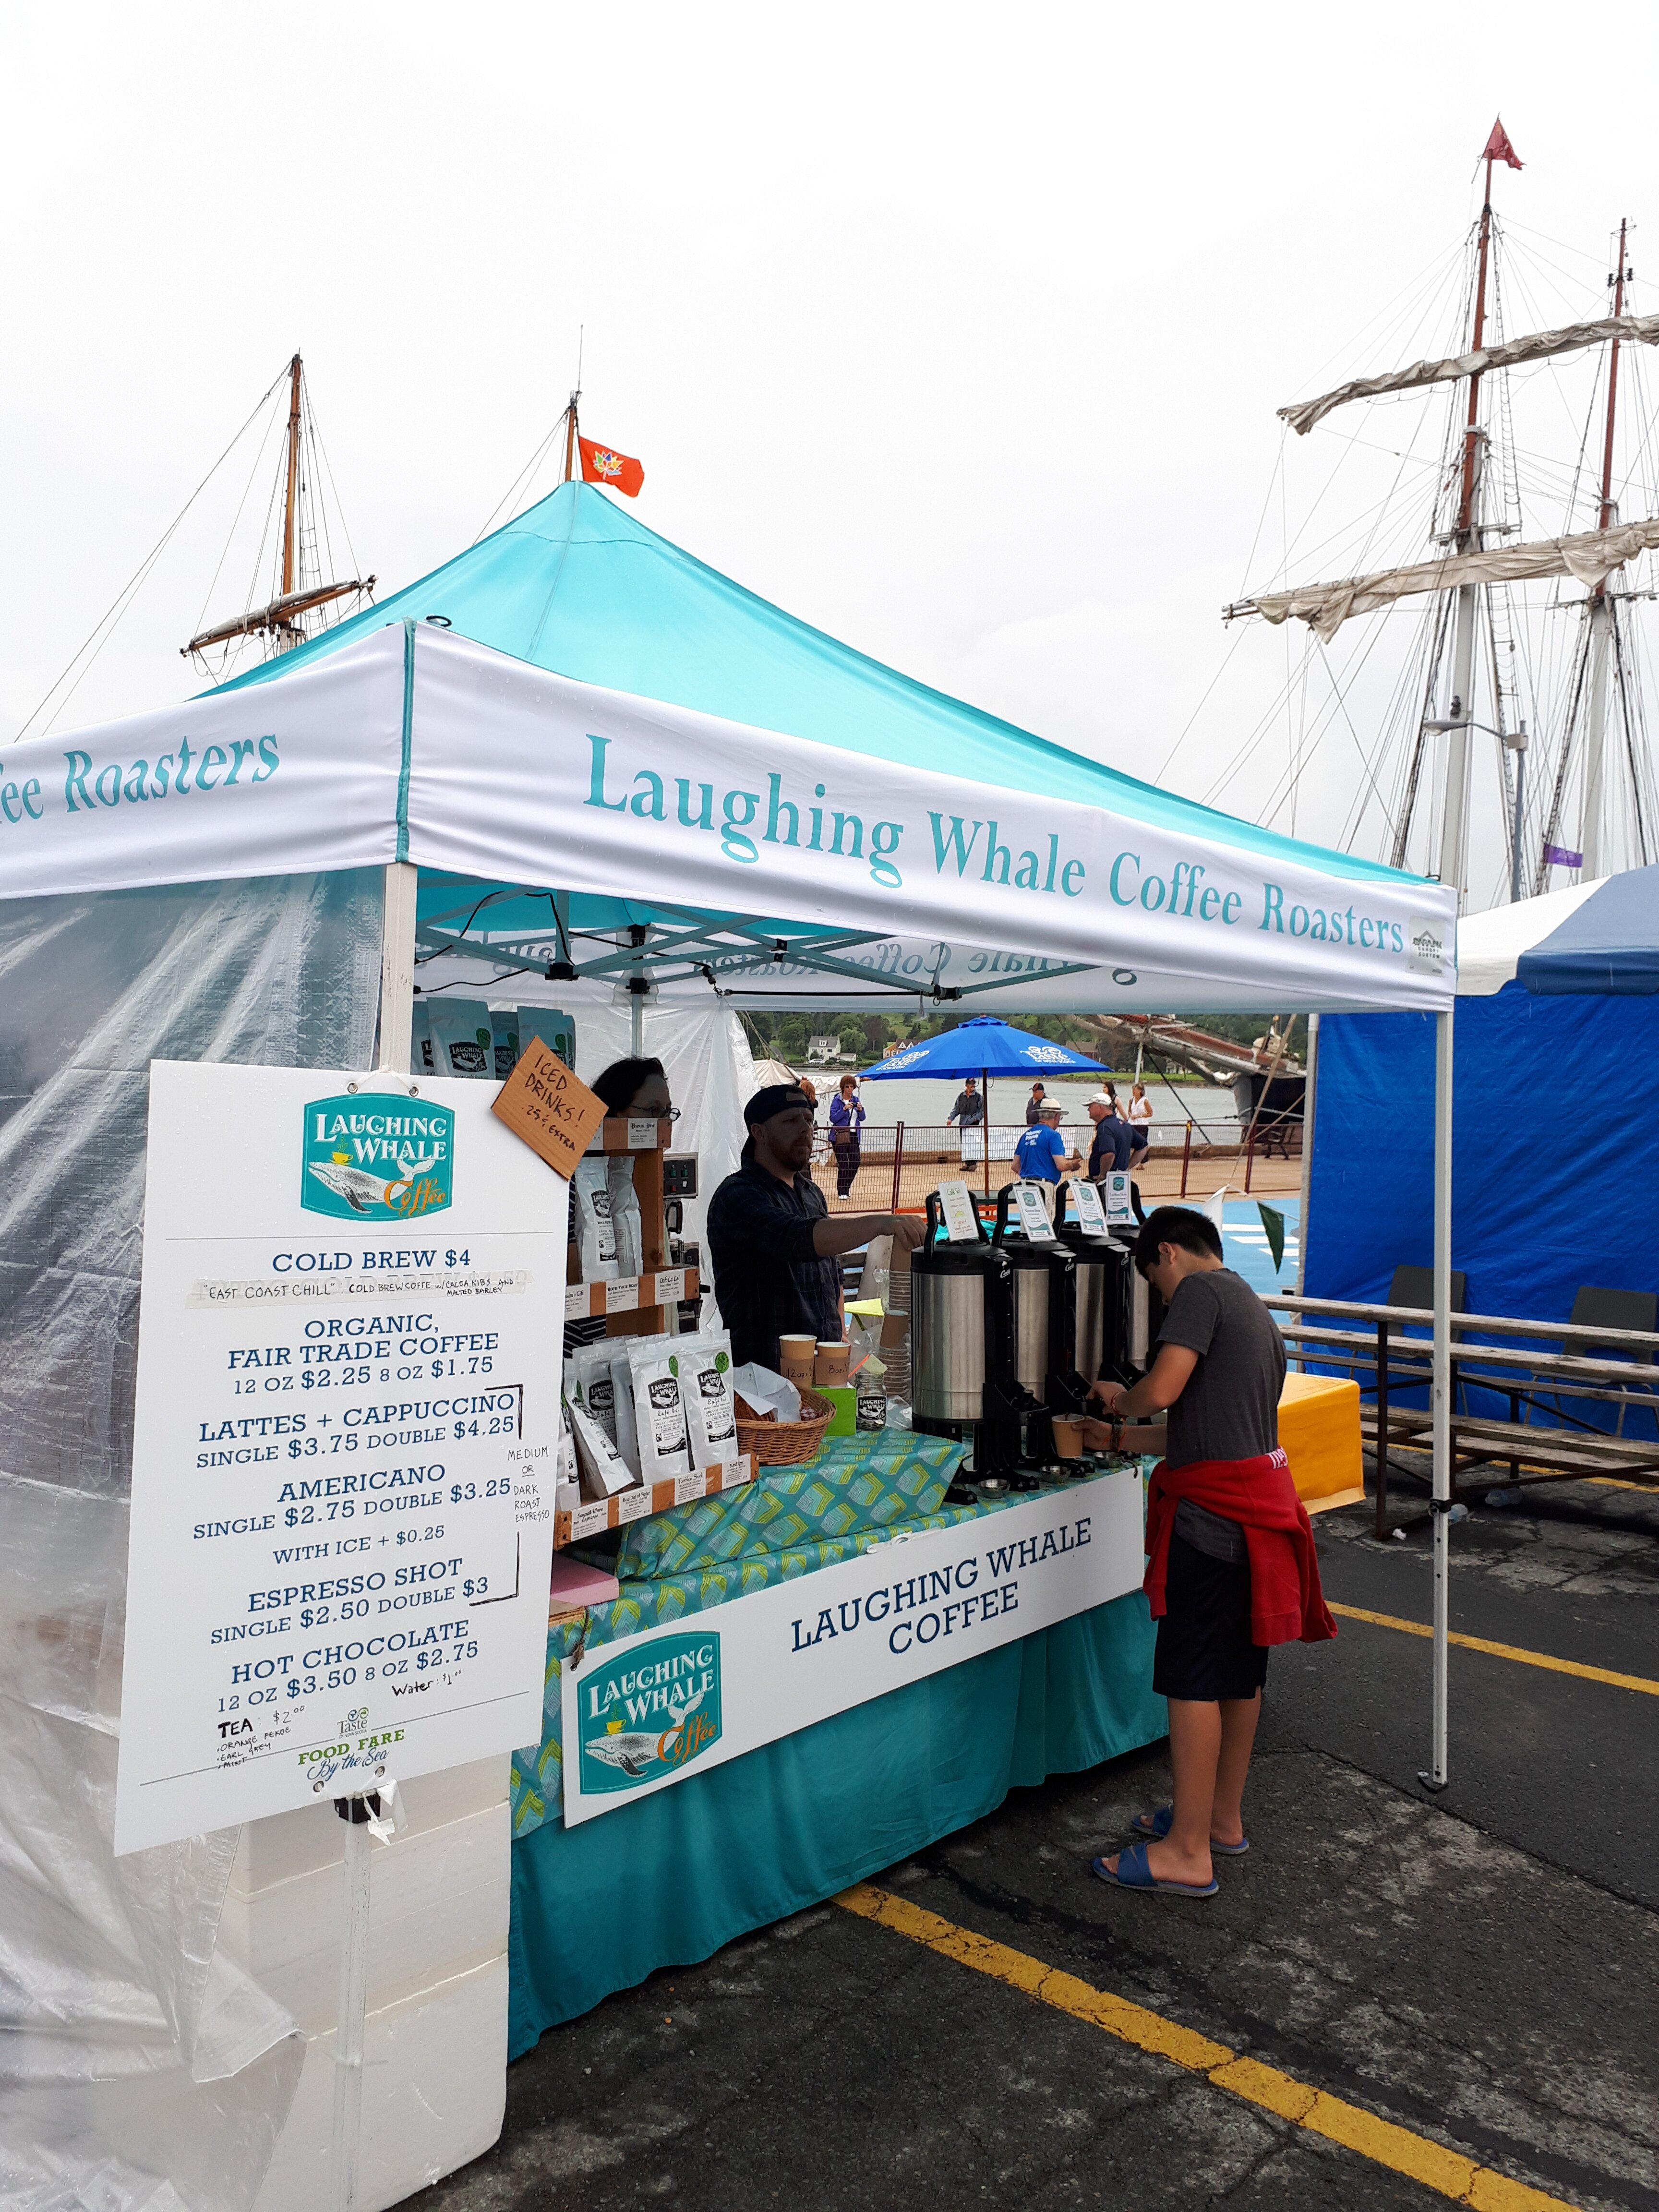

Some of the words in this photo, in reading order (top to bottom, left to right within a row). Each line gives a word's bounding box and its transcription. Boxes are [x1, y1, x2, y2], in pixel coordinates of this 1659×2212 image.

[63, 734, 279, 812] Roasters
[584, 734, 903, 887] Laughing
[928, 812, 1085, 896] Whale
[1110, 853, 1241, 924] Coffee
[1263, 881, 1404, 953] Roasters
[534, 1054, 567, 1090] ICED
[525, 1072, 585, 1127] DRINKS!
[314, 1112, 447, 1143] LAUGHING
[549, 1125, 575, 1151] EXTRA
[352, 1133, 447, 1161] WHALE
[384, 1177, 447, 1216] Coffee
[273, 1252, 352, 1272] COLD
[361, 1250, 438, 1269] BREW
[445, 1249, 471, 1268] $4
[204, 1284, 238, 1299] "EAST
[245, 1285, 289, 1298] COAST
[349, 1282, 375, 1293] COLD
[471, 1279, 491, 1287] NIBS
[475, 1286, 503, 1295] BARLEY
[305, 1314, 439, 1338] ORGANIC,
[228, 1347, 292, 1369] FAIR
[300, 1340, 391, 1364] TRADE
[399, 1333, 499, 1356] COFFEE
[235, 1379, 256, 1394] 12
[264, 1376, 294, 1391] OZ
[301, 1366, 371, 1390] $2.25
[380, 1368, 390, 1382] 8
[397, 1365, 423, 1380] OZ
[431, 1356, 493, 1379] $1.75
[650, 1382, 676, 1394] LAUGHING
[660, 1386, 677, 1396] WHALE
[199, 1414, 306, 1442] LATTES
[317, 1414, 333, 1428] +
[343, 1394, 514, 1427] CAPPUCCINO
[197, 1445, 278, 1468] SINGLE
[288, 1433, 358, 1460] $3.75
[367, 1427, 446, 1449] DOUBLE
[454, 1416, 514, 1440] $4.25
[508, 1446, 548, 1460] MEDIUM
[277, 1464, 445, 1503] AMERICANO
[522, 1465, 534, 1474] OR
[514, 1484, 539, 1495] DARK
[515, 1497, 541, 1510] ROAST
[193, 1515, 275, 1539] SINGLE
[284, 1500, 355, 1528] $2.75
[363, 1491, 443, 1515] DOUBLE
[450, 1478, 510, 1503] $3.25
[516, 1510, 550, 1522] ESPRESSO
[272, 1543, 329, 1564] WITH
[336, 1537, 371, 1555] ICE
[378, 1536, 389, 1546] +
[396, 1525, 444, 1546] $0.25
[248, 1572, 385, 1612] ESPRESSO
[395, 1558, 462, 1587] SHOT
[791, 1557, 979, 1652] LAUGHING
[986, 1518, 1093, 1577] WHALE
[211, 1617, 291, 1644] SINGLE
[300, 1599, 369, 1629] $2.50
[377, 1586, 455, 1613] DOUBLE
[463, 1576, 488, 1598] $3
[889, 1582, 1019, 1654] COFFEE
[231, 1655, 294, 1684] HOT
[302, 1619, 469, 1669] CHOCOLATE
[218, 1695, 240, 1712] 12
[248, 1687, 277, 1705] OZ
[287, 1667, 356, 1699] $3.50
[365, 1667, 375, 1681] 8
[382, 1659, 408, 1676] OZ
[416, 1640, 478, 1671] $2.75
[589, 1645, 714, 1718] LAUGHING
[625, 1669, 714, 1726] WHALE
[264, 1727, 291, 1740] PEKOE
[337, 1718, 368, 1734] Taste
[658, 1711, 716, 1767] Coffee
[249, 1742, 271, 1756] GREY
[298, 1743, 350, 1765] FOOD
[358, 1729, 405, 1751] FARE
[307, 1759, 337, 1781] By
[337, 1750, 362, 1769] the
[362, 1747, 390, 1767] Sea
